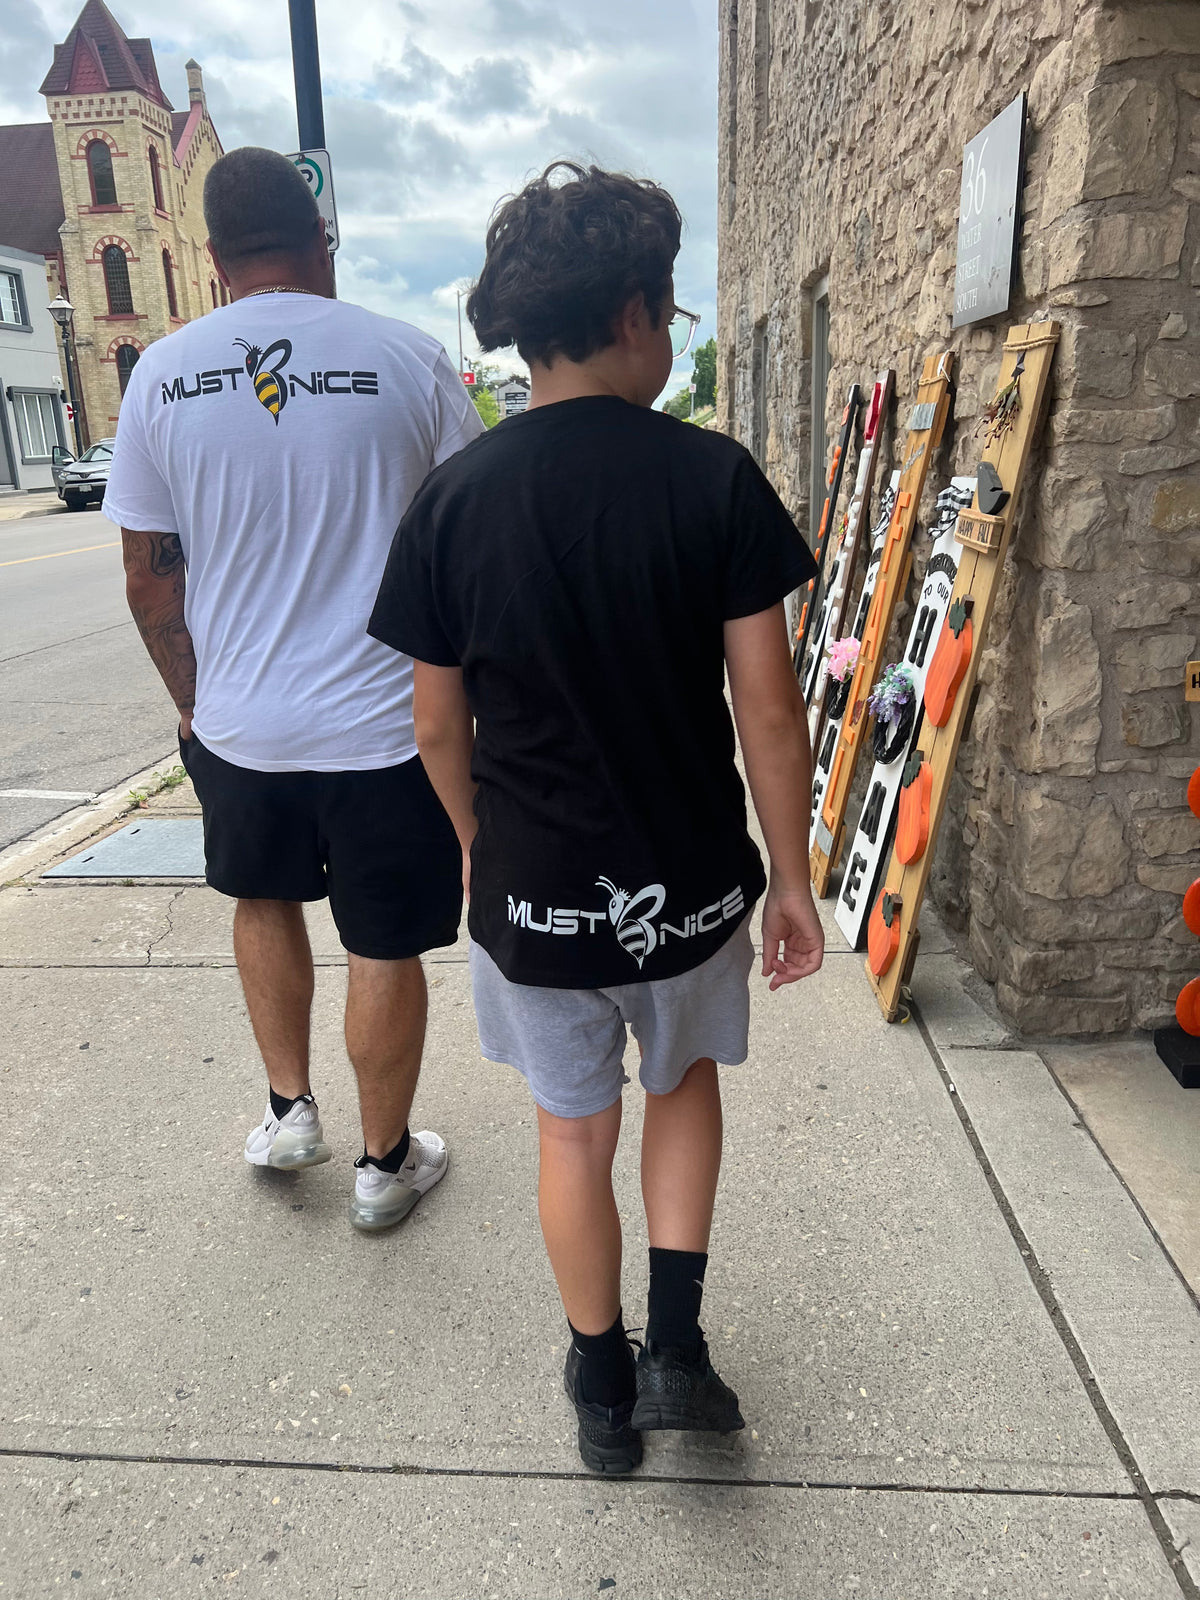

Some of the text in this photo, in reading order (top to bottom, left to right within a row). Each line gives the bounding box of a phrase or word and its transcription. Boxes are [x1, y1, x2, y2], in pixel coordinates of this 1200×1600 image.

[962, 136, 989, 224] 36
[961, 222, 982, 250] WATER
[957, 254, 981, 284] STREET
[956, 287, 978, 314] SOUTH
[161, 367, 244, 405] MUST
[924, 583, 948, 603] TO OUR
[507, 894, 607, 935] MUST
